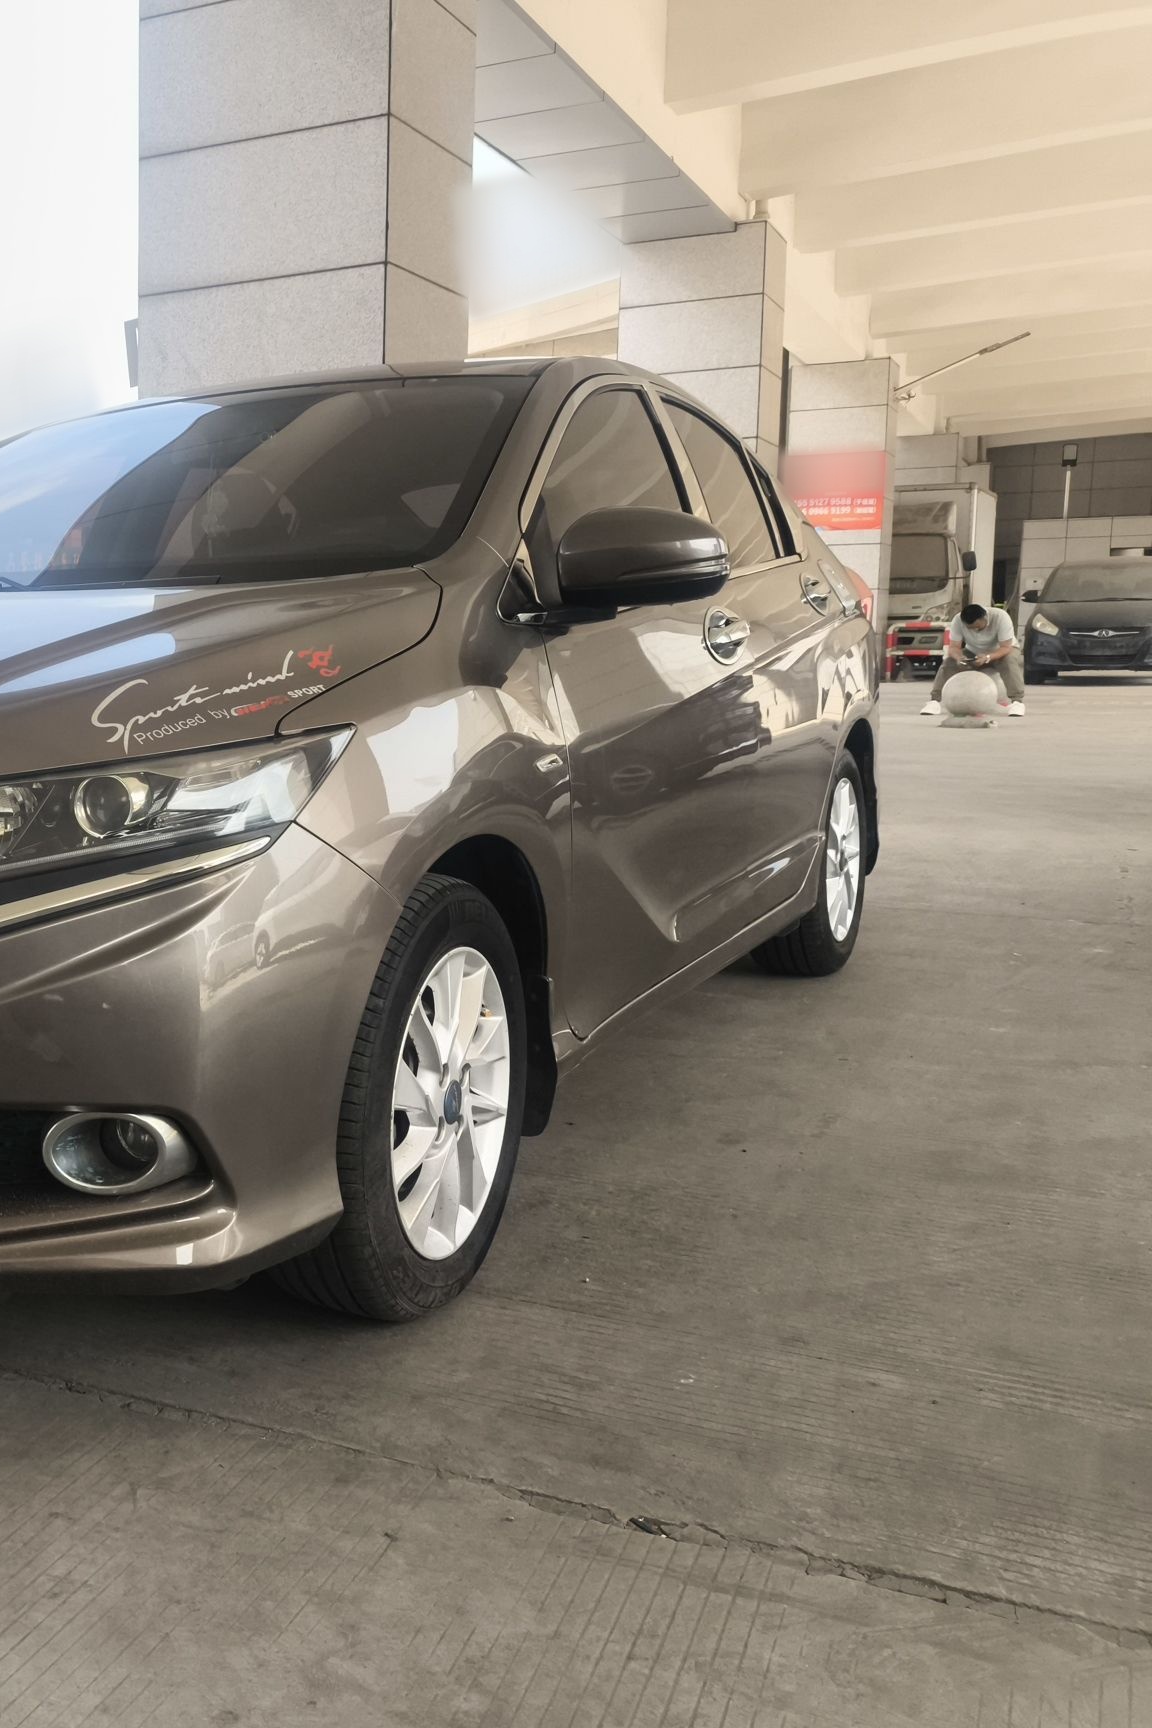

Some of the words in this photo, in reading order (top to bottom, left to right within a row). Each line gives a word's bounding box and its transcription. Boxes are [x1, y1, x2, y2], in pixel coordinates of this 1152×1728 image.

[133, 713, 206, 745] Produced
[210, 707, 232, 721] by
[287, 684, 327, 699] SPORT
